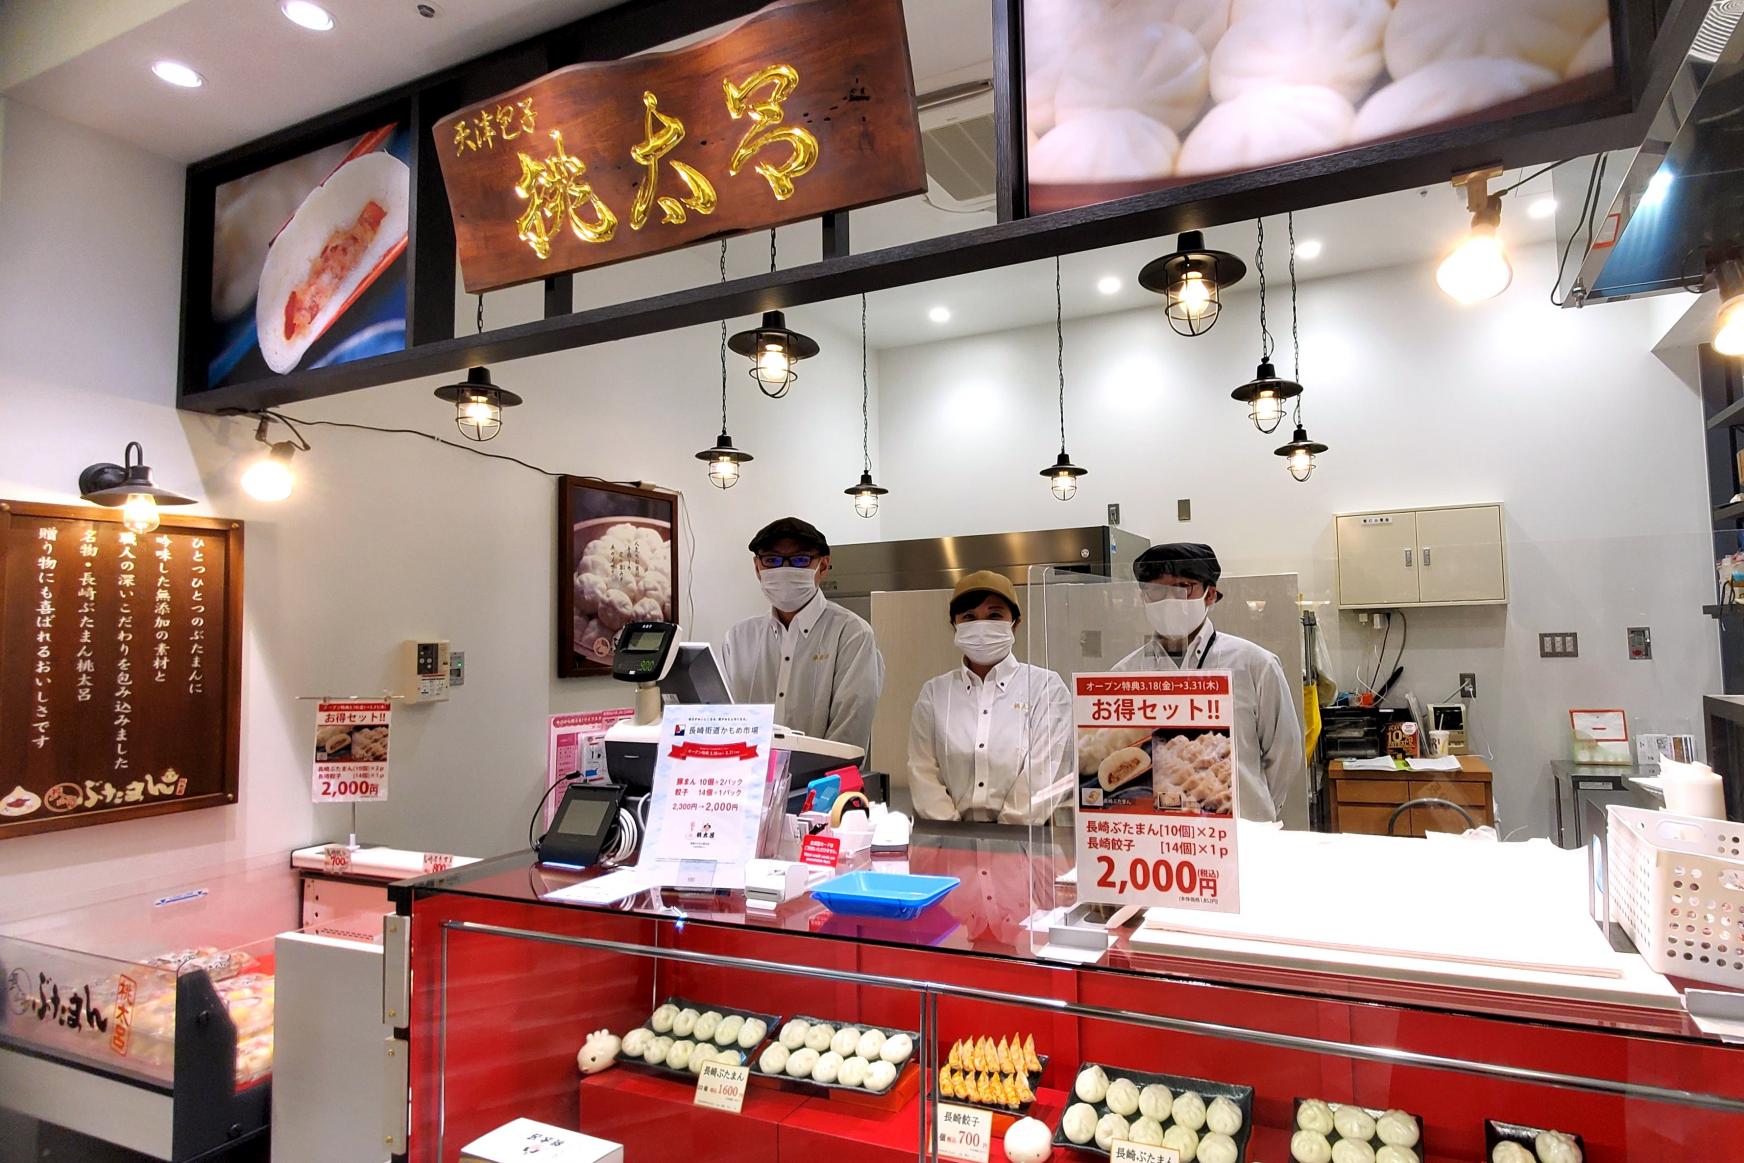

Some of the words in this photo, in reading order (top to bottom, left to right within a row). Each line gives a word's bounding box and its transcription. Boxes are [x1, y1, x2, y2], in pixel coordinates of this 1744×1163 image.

[453, 96, 538, 157] 天津包子
[153, 534, 173, 682] 吟味した無添加の素材と
[189, 538, 205, 694] ひとつひとつのぶたまんに
[32, 526, 58, 749] 贈り物にも喜ばれるおいしさです
[1092, 698, 1220, 722] お得セット!!
[689, 726, 759, 735] 長崎街道かもめ市場
[1087, 837, 1136, 852] 長崎餃子
[704, 1065, 745, 1082] 長崎ぶたまん
[944, 1112, 981, 1127] 長崎餃子
[959, 1131, 980, 1147] 700
